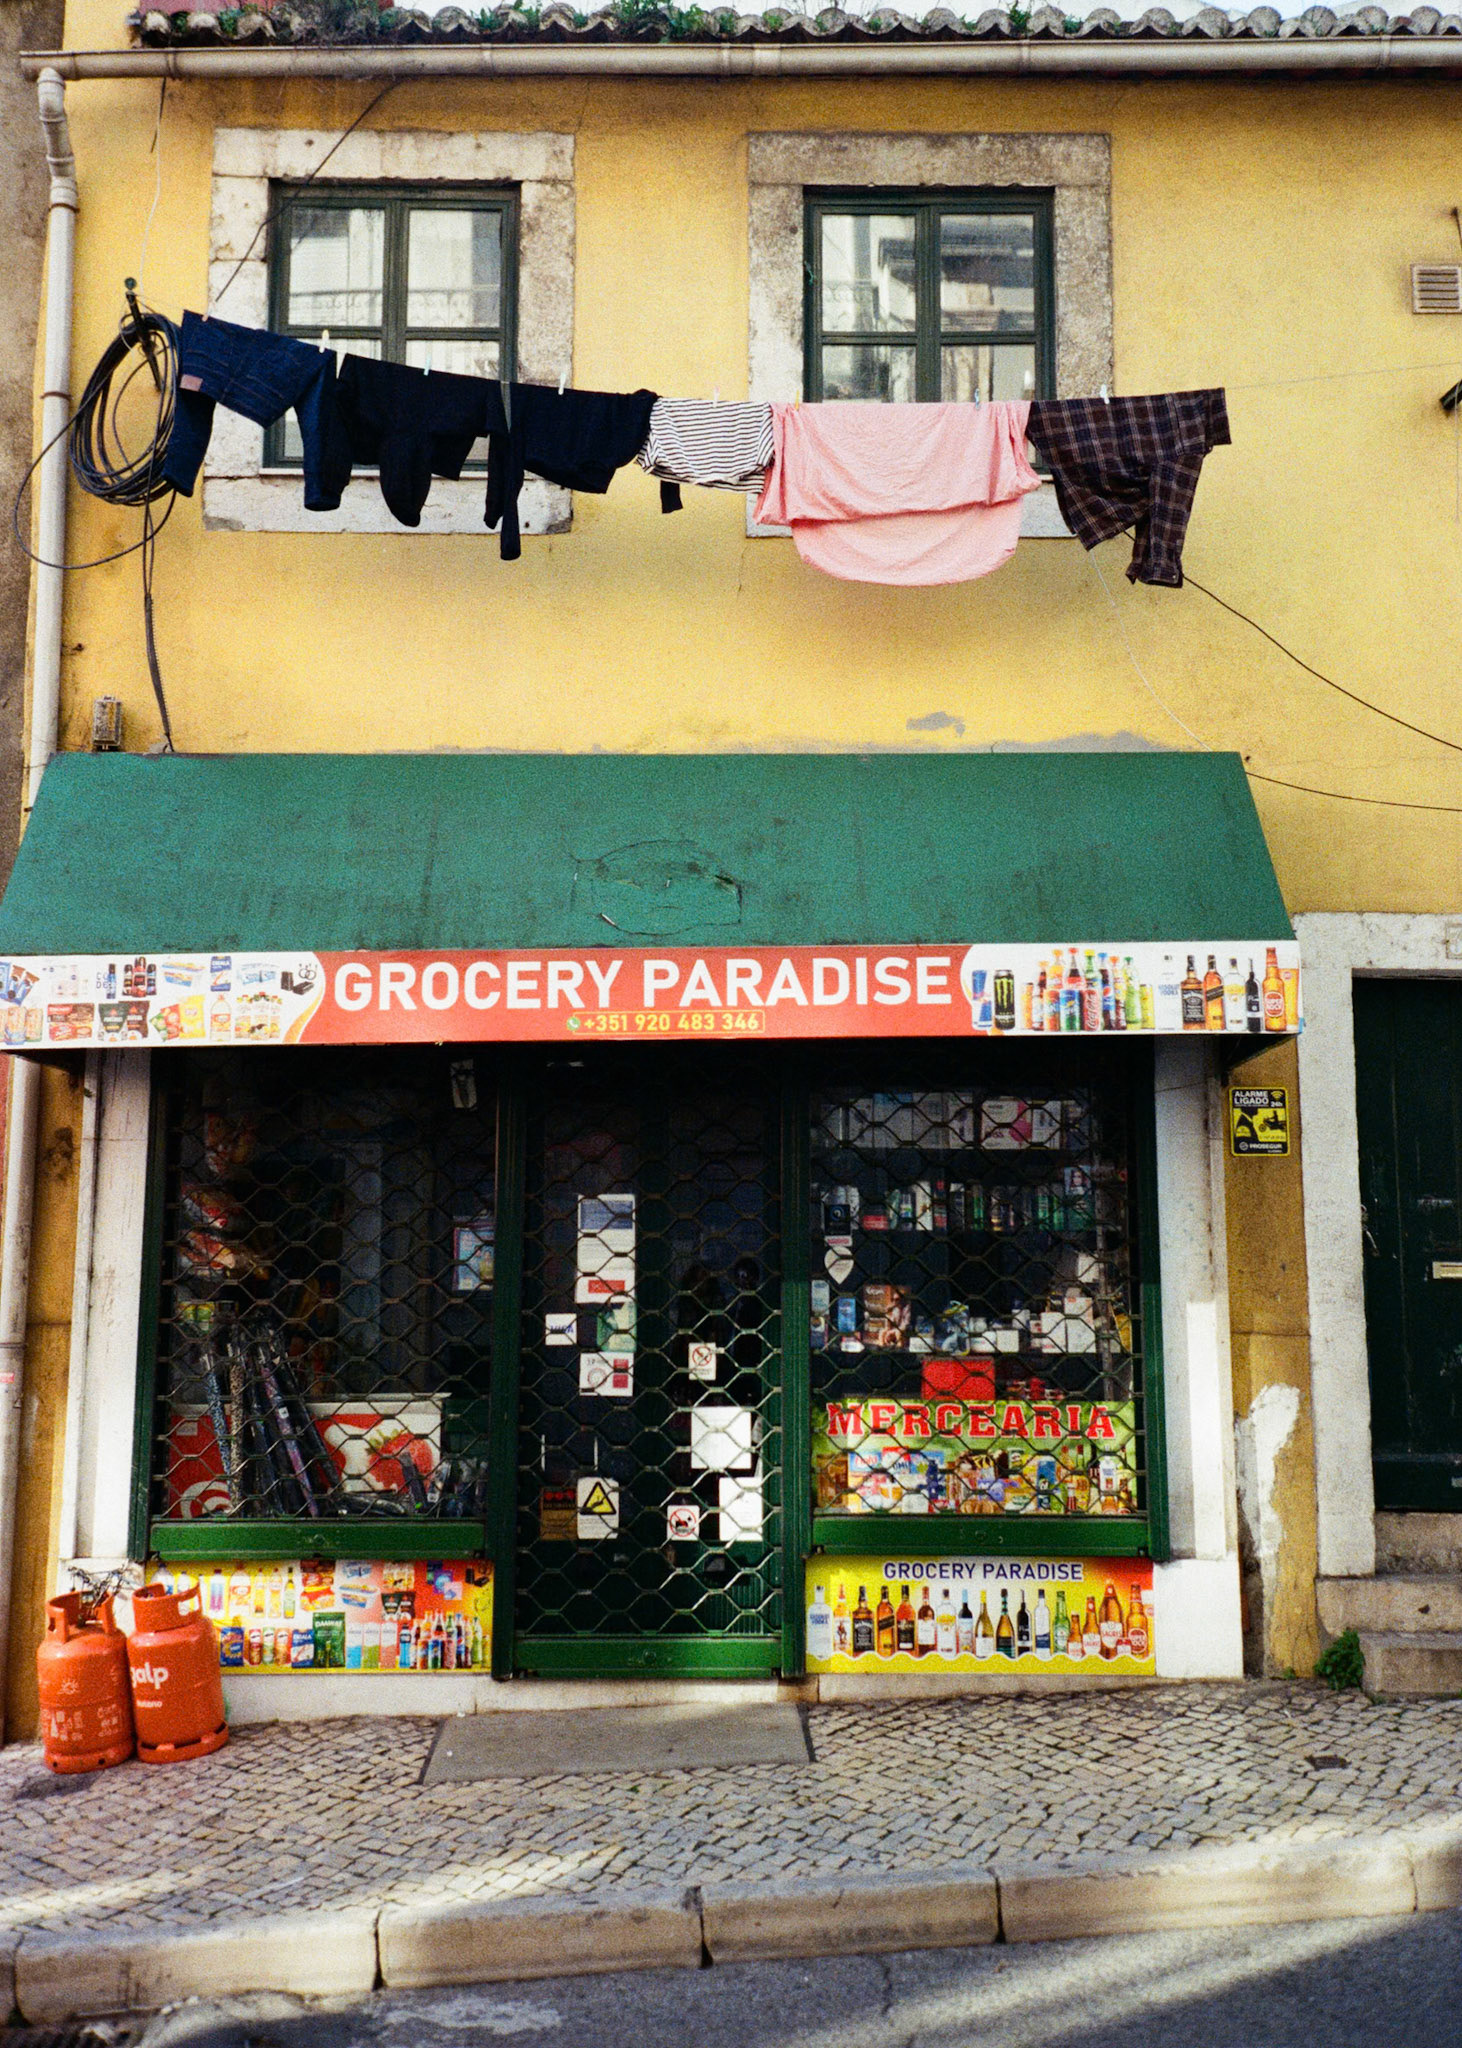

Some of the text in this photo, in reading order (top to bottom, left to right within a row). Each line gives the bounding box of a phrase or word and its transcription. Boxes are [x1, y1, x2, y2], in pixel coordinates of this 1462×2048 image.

[333, 956, 953, 1010] GROCERY PARADISE
[584, 1012, 759, 1032] +351 920 483 346
[1233, 1097, 1269, 1105] LIGADO
[826, 1402, 1116, 1439] MERCEARIA
[883, 1562, 1083, 1580] GROCERY PARADISE
